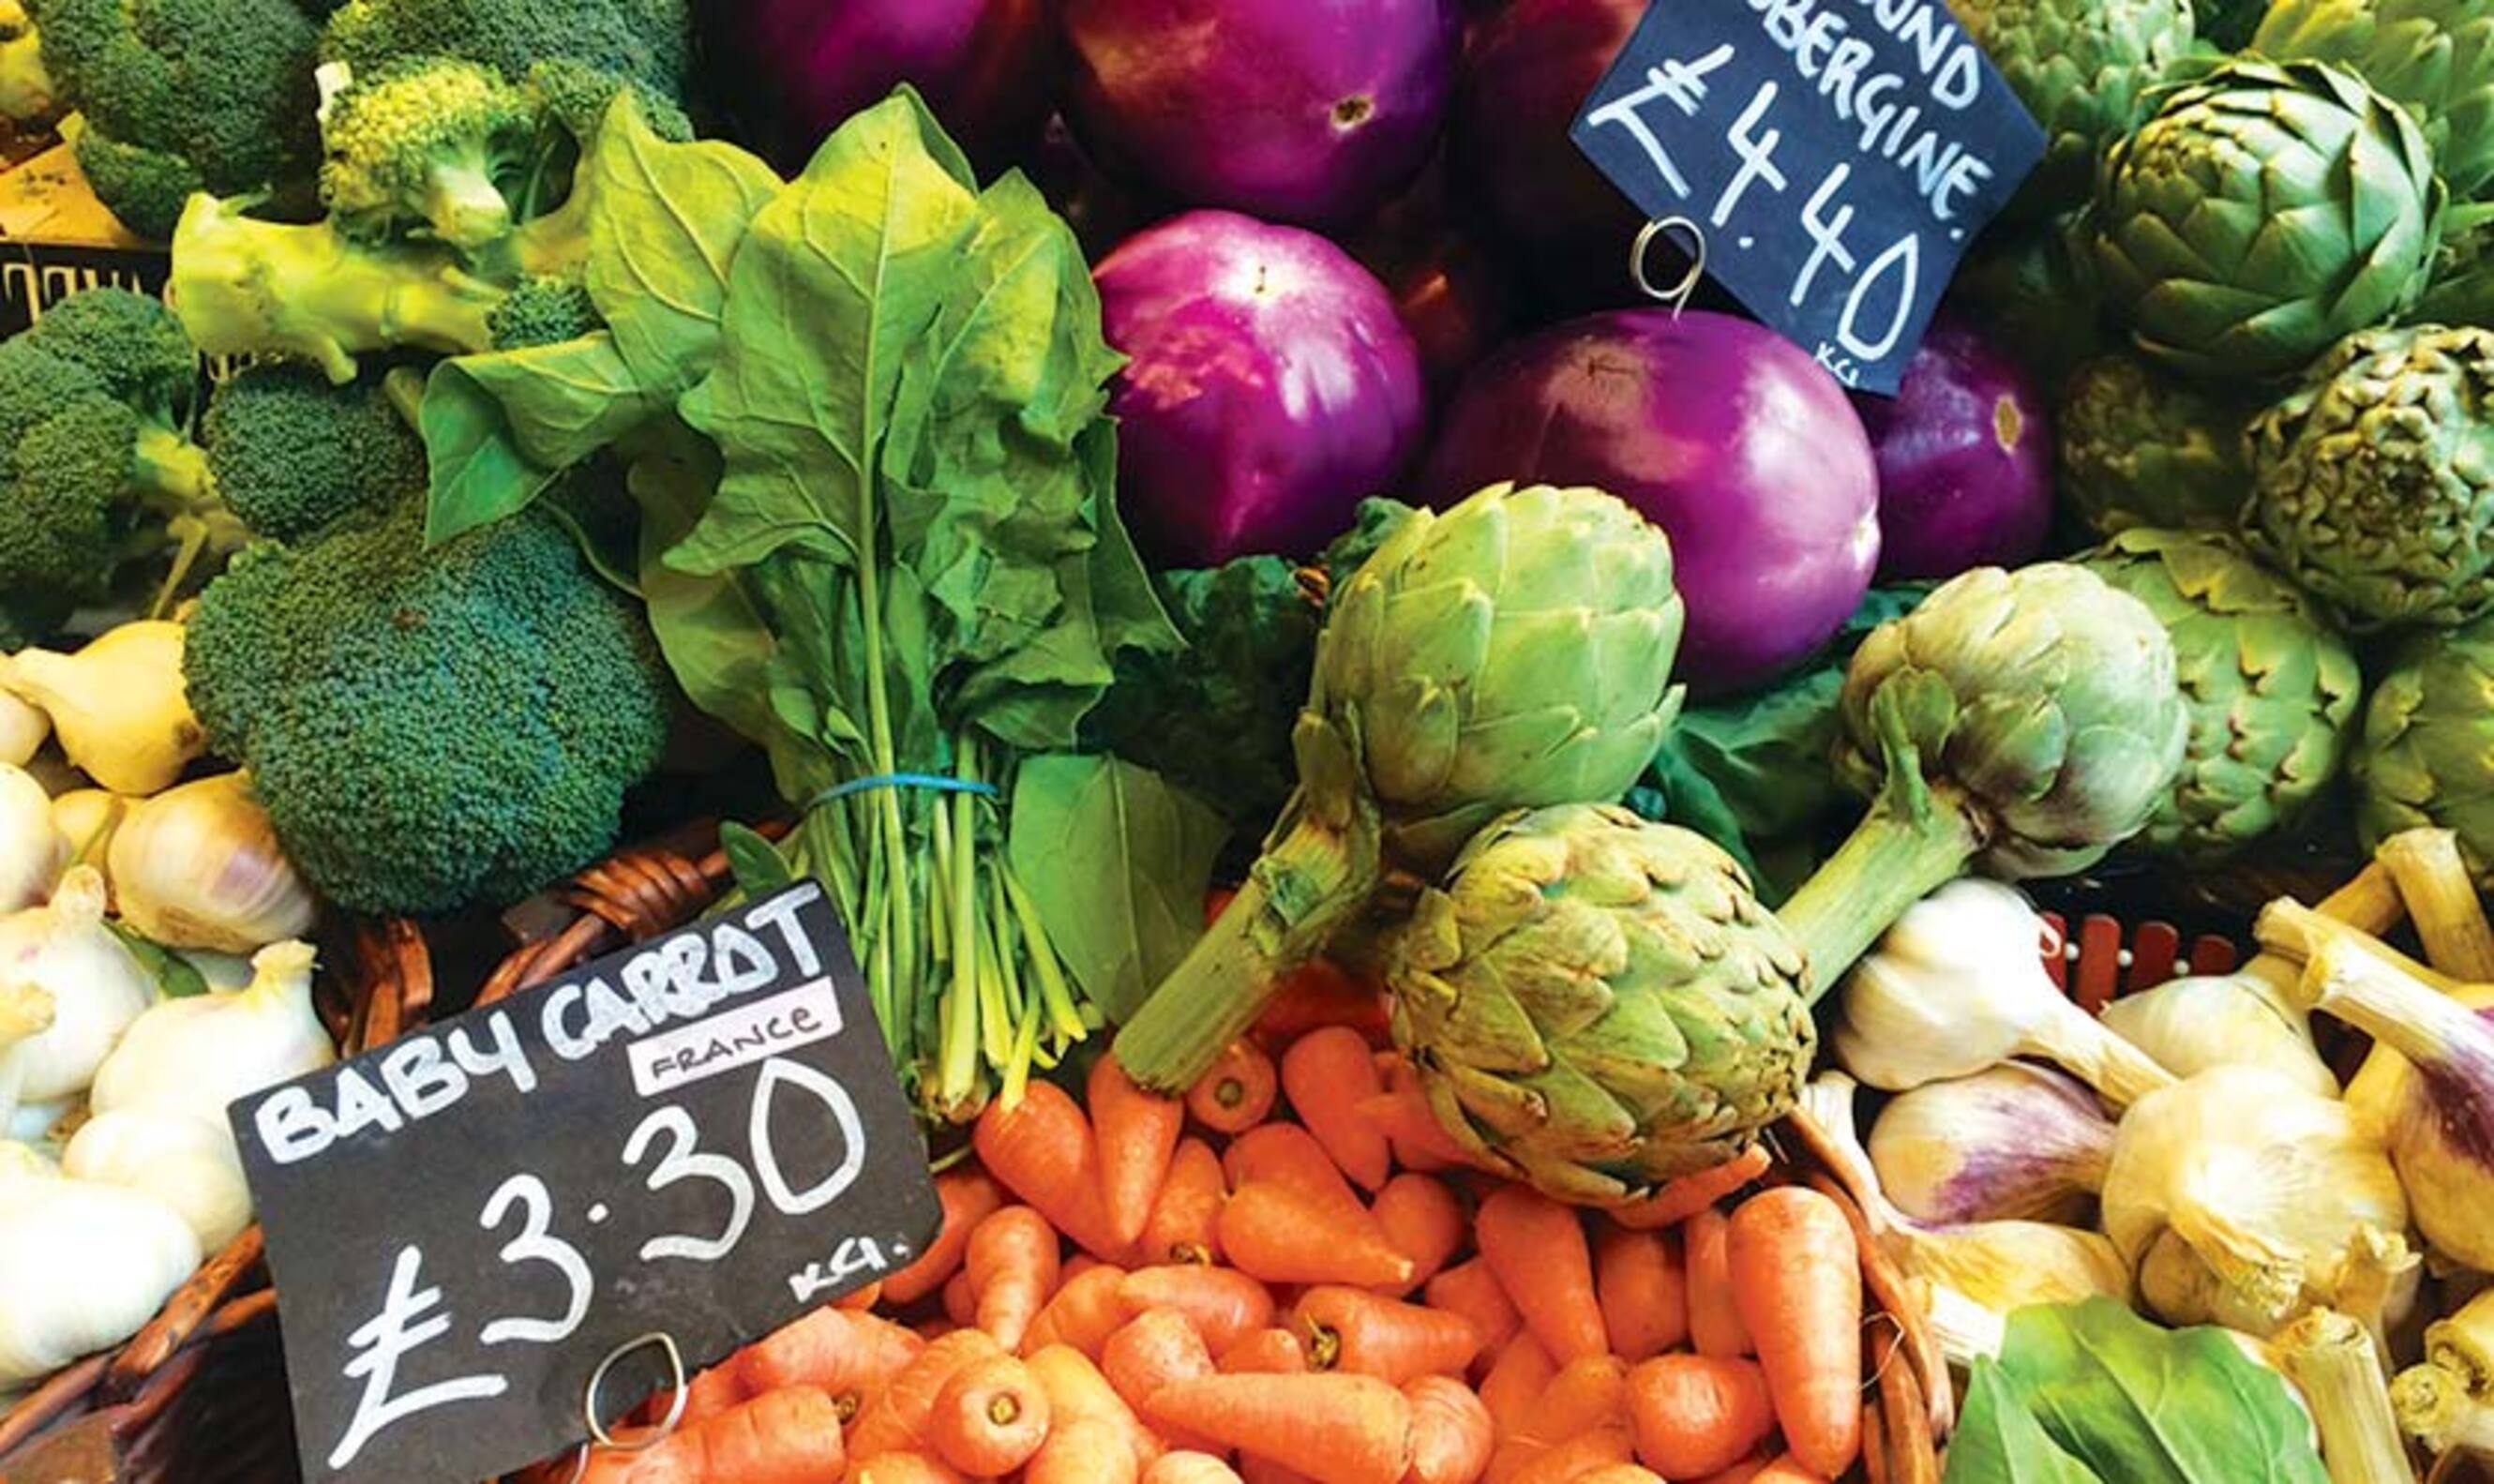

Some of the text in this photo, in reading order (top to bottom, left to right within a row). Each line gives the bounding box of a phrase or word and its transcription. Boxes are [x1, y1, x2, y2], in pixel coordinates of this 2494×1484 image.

[1747, 0, 1995, 239] BERGINE.
[1859, 0, 1980, 110] UND
[1586, 43, 1919, 362] £4.40
[253, 883, 821, 1163] BABY CARROT
